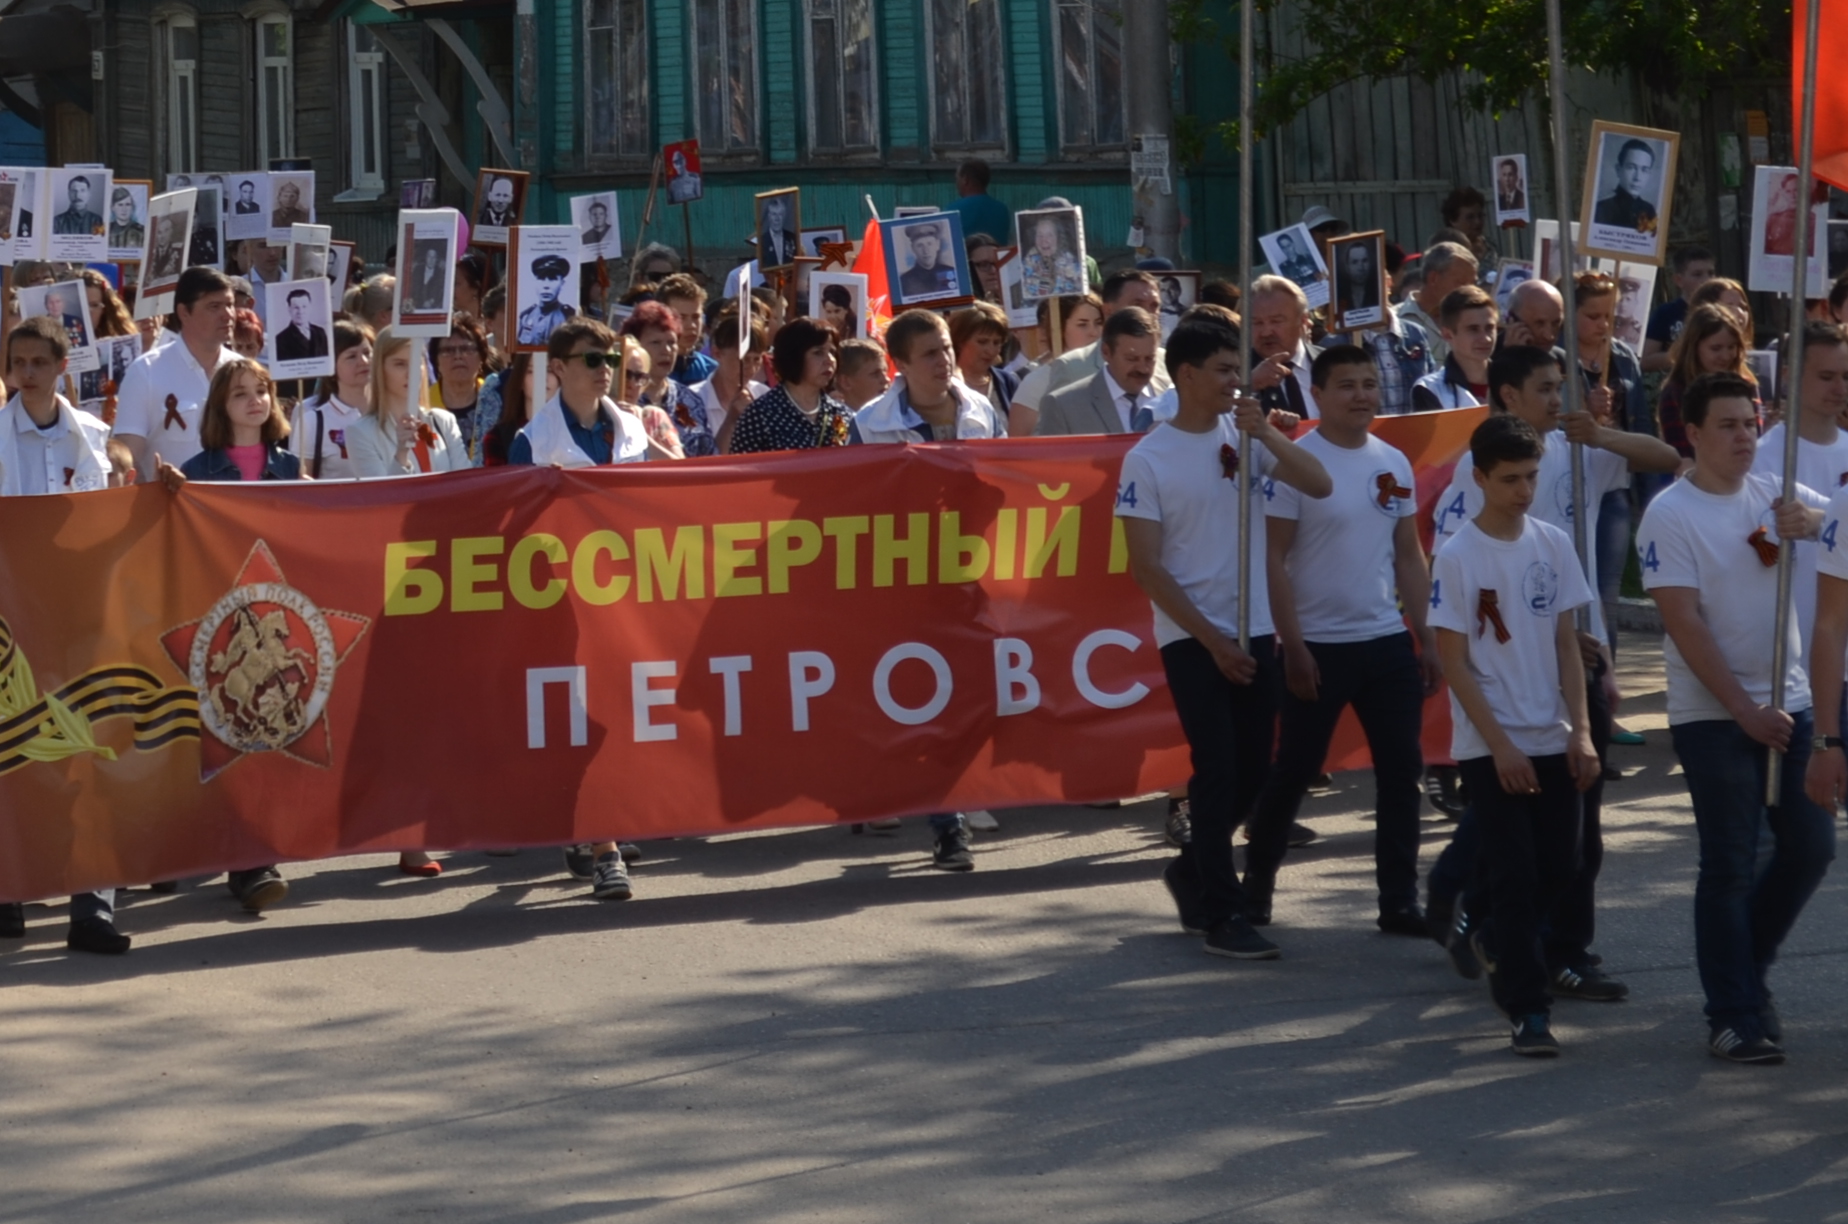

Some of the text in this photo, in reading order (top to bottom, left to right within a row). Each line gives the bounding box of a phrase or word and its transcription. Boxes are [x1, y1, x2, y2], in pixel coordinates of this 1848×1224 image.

[1262, 479, 1276, 502] 4
[1447, 491, 1466, 519] 4
[384, 482, 1081, 617] БЕССМЕРТНЫЙ
[1821, 519, 1839, 553] 4
[1429, 579, 1442, 609] 4
[265, 585, 307, 614] ПОЛК
[308, 613, 332, 692] РОССИИ
[526, 628, 1151, 750] ПЕТРОВС
